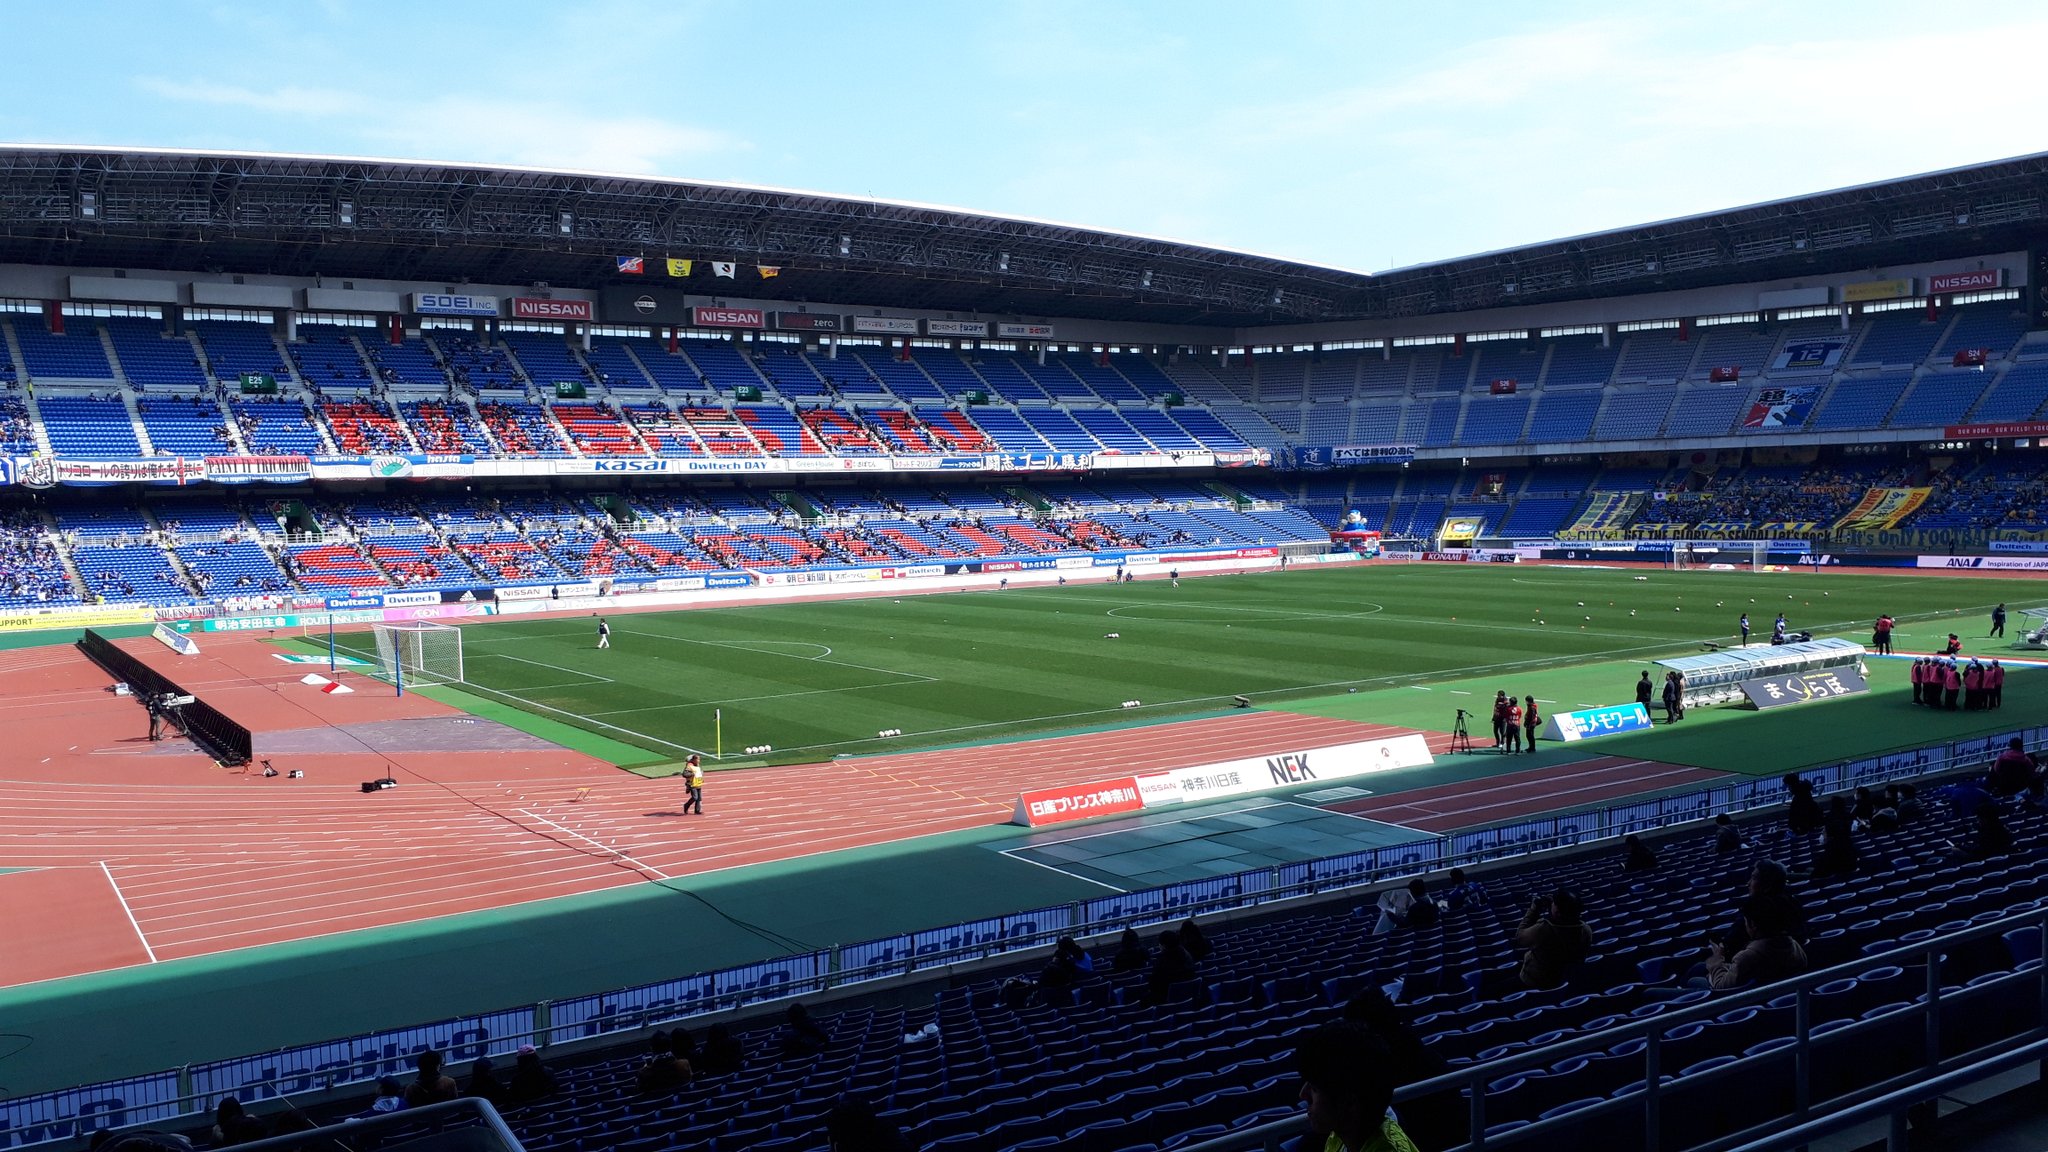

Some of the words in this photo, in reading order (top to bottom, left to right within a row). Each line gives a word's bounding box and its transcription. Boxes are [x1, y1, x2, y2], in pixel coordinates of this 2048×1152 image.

[1934, 273, 1993, 289] NISSAN
[423, 295, 472, 309] SOEI
[521, 302, 585, 316] NISSAN
[701, 311, 758, 324] NISSAN
[1800, 348, 1823, 361] 12
[248, 375, 263, 384] E25
[560, 382, 572, 390] E24
[738, 385, 749, 394] E23
[208, 458, 238, 474] PAINT
[242, 458, 252, 473] IT
[256, 457, 310, 473] TRICOLORE
[689, 461, 742, 470] Owltech
[744, 461, 767, 470] DAY
[595, 496, 608, 505] E14
[1577, 530, 1606, 540] CITY
[1427, 552, 1462, 560] KONAMI
[988, 563, 1015, 571] NISSAN
[1946, 558, 1970, 567] ANA
[1987, 561, 2022, 569] Inspiration
[909, 567, 941, 575] Owltech
[708, 577, 747, 587] Owltech
[786, 573, 826, 583] 朝日新聞
[503, 588, 541, 597] NISSAN
[330, 597, 379, 608] Owltech
[389, 594, 436, 604] Owltech
[214, 617, 287, 631] 明治安田生命
[1589, 707, 1648, 733] メモワール
[1266, 753, 1318, 785] NEK
[1140, 783, 1177, 795] NISSAN
[1180, 771, 1243, 793] 神奈川日産
[1029, 786, 1137, 818] 日産プリンス神奈川
